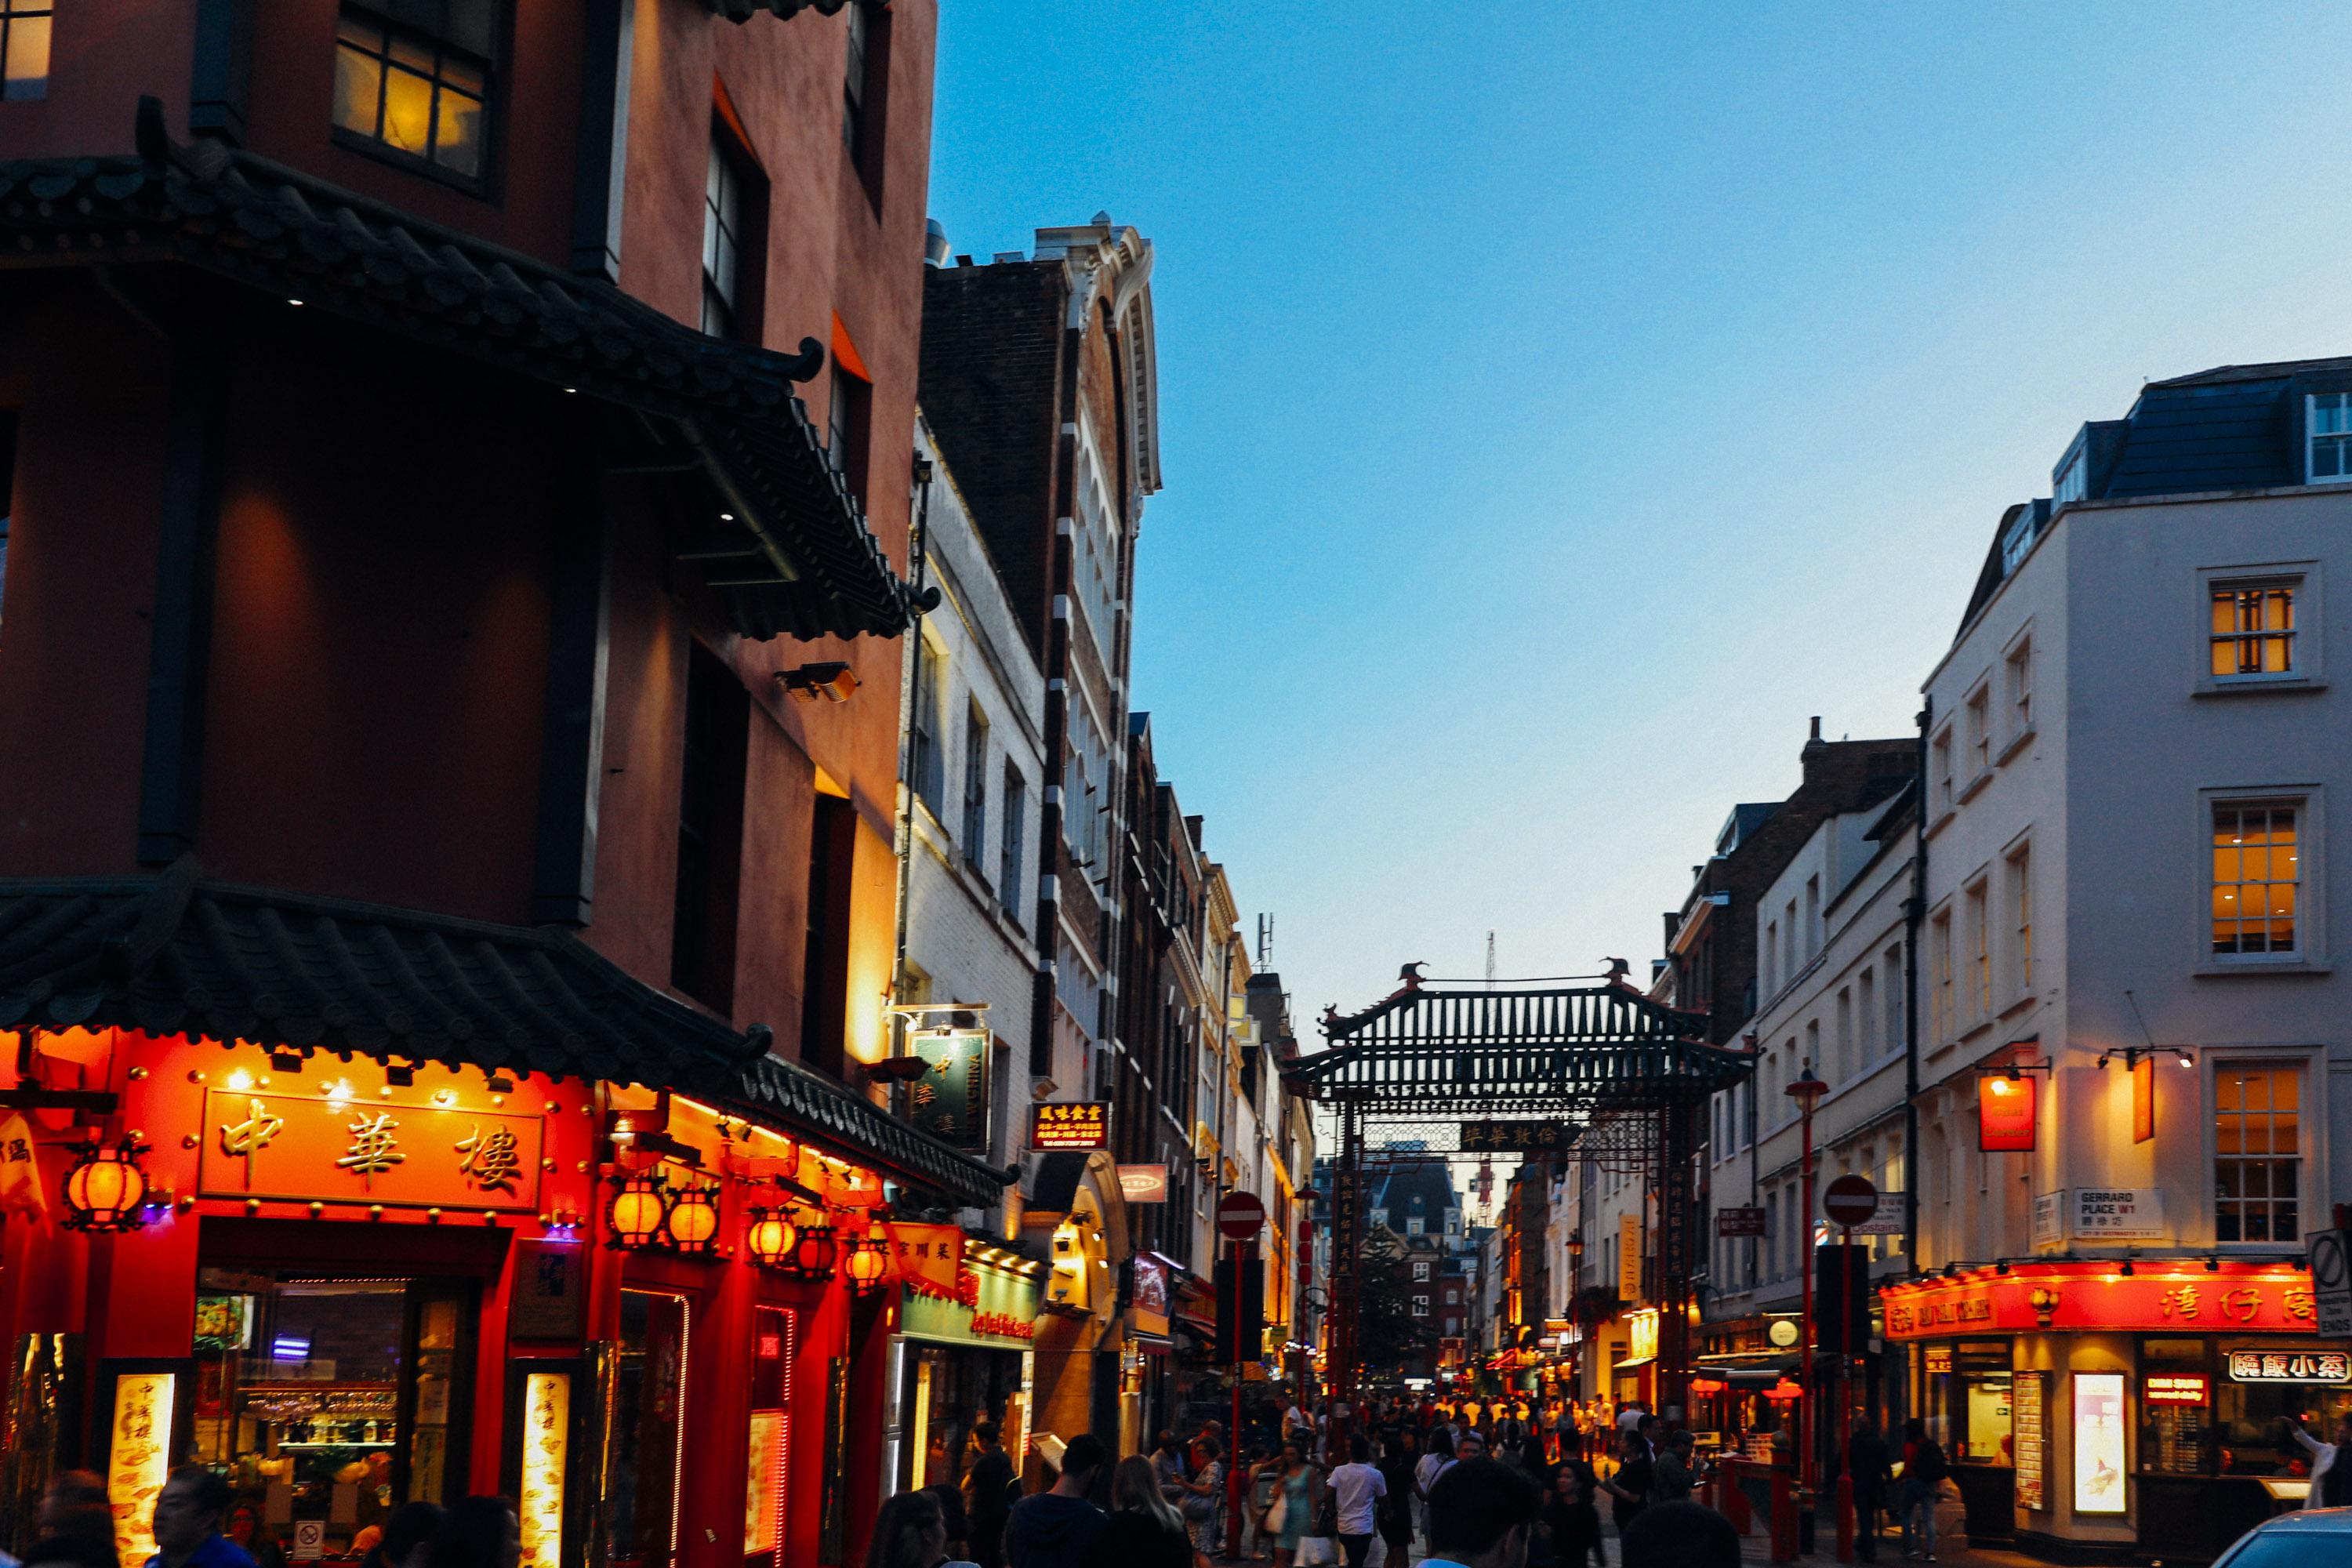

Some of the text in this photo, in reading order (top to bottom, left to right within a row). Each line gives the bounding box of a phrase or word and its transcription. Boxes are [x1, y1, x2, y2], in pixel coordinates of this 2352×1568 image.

[966, 1053, 981, 1100] CHINA
[1984, 1127, 2031, 1138] Corner
[220, 1098, 524, 1199] 中華樓
[2082, 1192, 2133, 1203] GERRARD
[2082, 1204, 2136, 1214] PLACE W1
[2321, 1319, 2351, 1332] ENDS
[2234, 1354, 2347, 1378] 晚飯小菜
[2148, 1378, 2203, 1388] DIM SUM
[2179, 1390, 2203, 1401] daily
